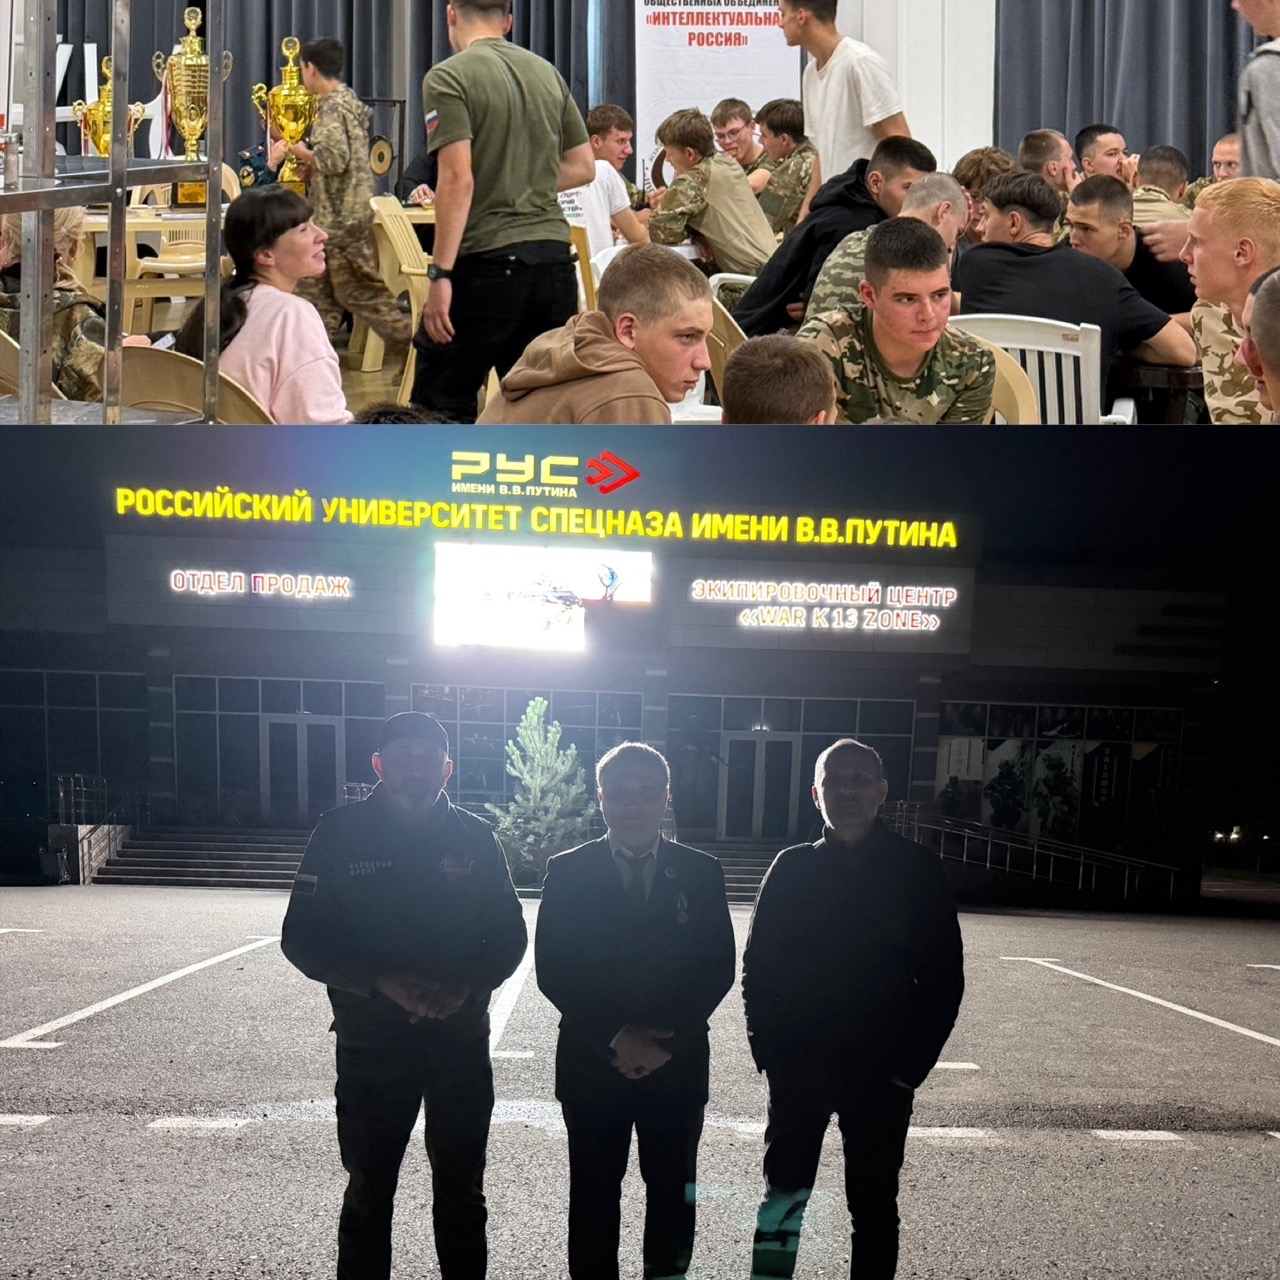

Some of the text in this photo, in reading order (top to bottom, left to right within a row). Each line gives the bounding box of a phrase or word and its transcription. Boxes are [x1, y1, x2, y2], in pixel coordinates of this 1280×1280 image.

[646, 11, 780, 26] «ИНТЕЛЛЕКТУАЛЬНА
[688, 32, 748, 46] РОССИЯ»
[451, 451, 579, 485] РУС
[451, 482, 578, 498] ИМЕНИ В.В.ПУТИНА
[116, 486, 957, 548] РОССИЙСКИЙ УНИВЕРСИТЕТ СПЕЦНАЗА ИМЕНИ В.В.ПУТИНА
[171, 569, 350, 597] ОТДЕЛ ПРОДАЖ
[692, 578, 958, 607] ЭКИПИРОВОЧНЫЙ ЦЕНТР
[863, 609, 940, 631] ZONE»
